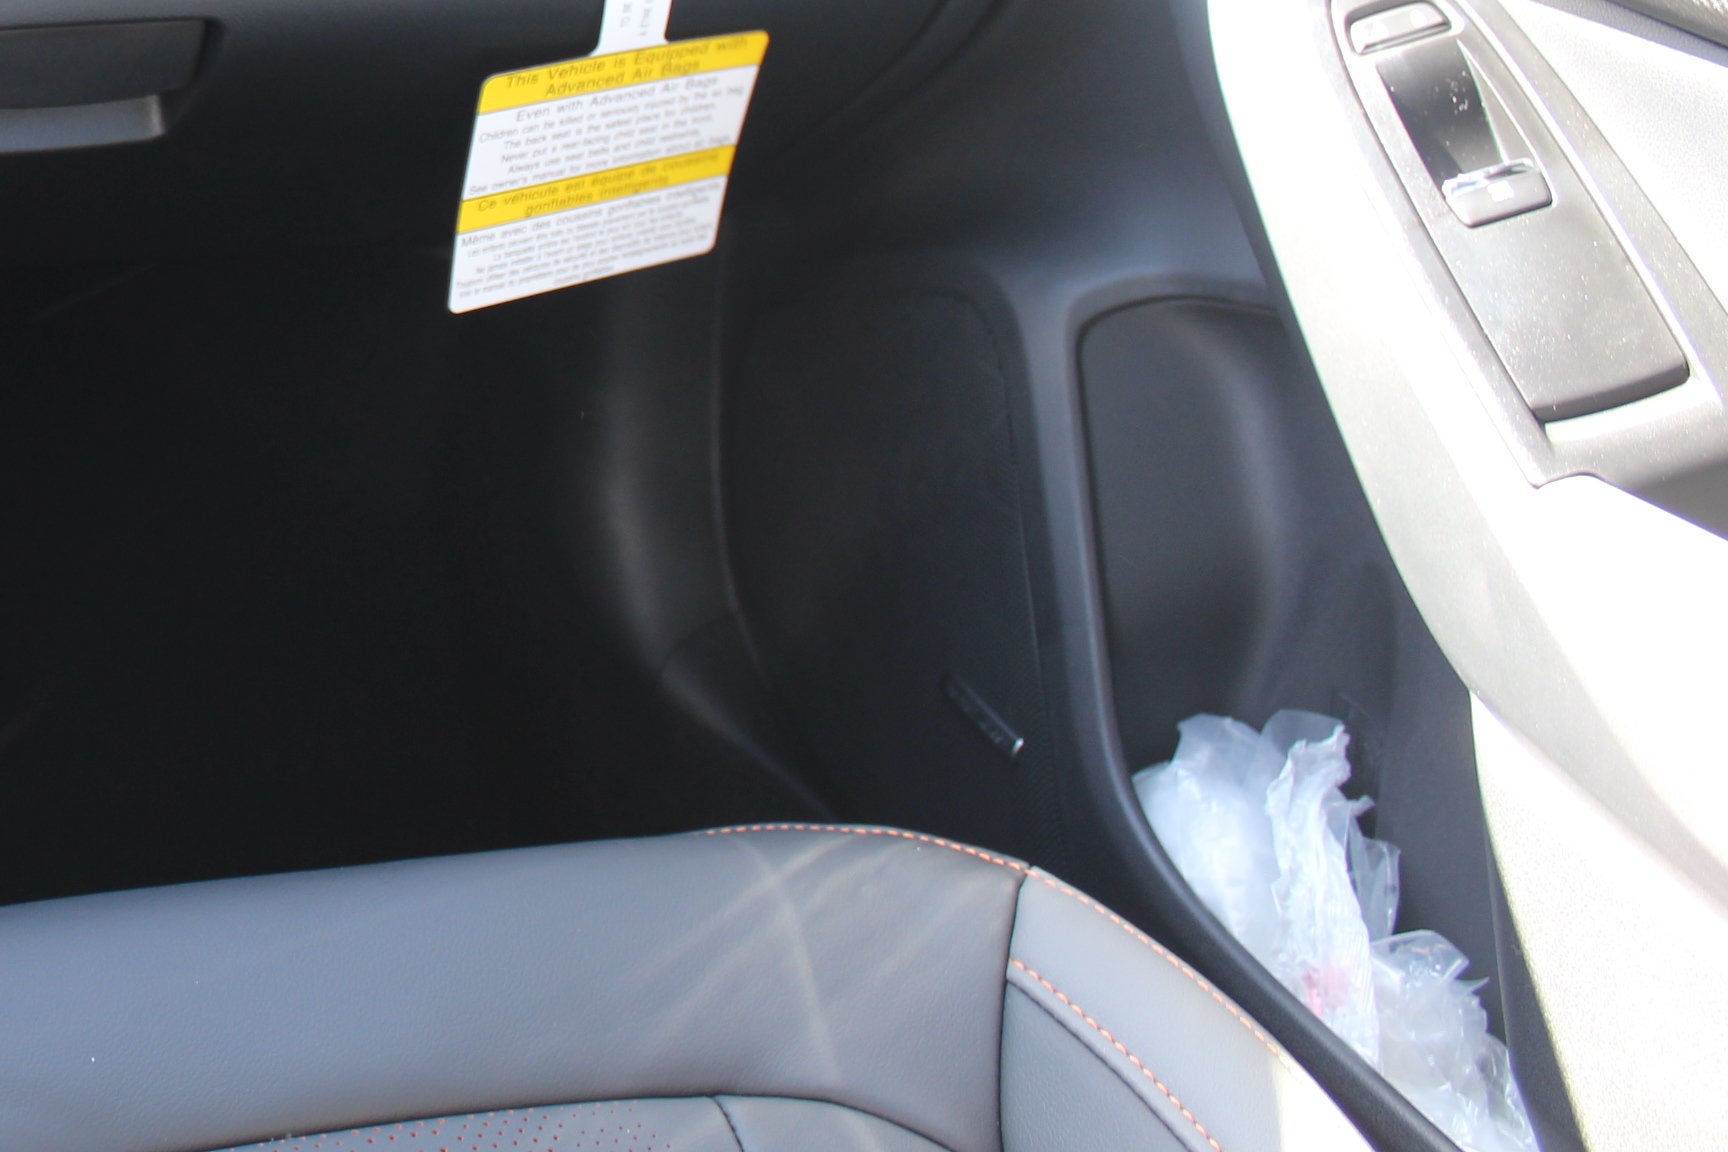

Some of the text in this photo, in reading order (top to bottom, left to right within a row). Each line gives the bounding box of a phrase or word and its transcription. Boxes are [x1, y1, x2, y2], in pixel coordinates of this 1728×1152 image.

[506, 72, 538, 89] This
[547, 59, 605, 81] Vehicle
[634, 43, 707, 67] Equipped
[545, 57, 699, 97] Advanced Air Bags
[515, 105, 549, 122] Even
[556, 99, 582, 114] with
[590, 85, 655, 107] Advanced
